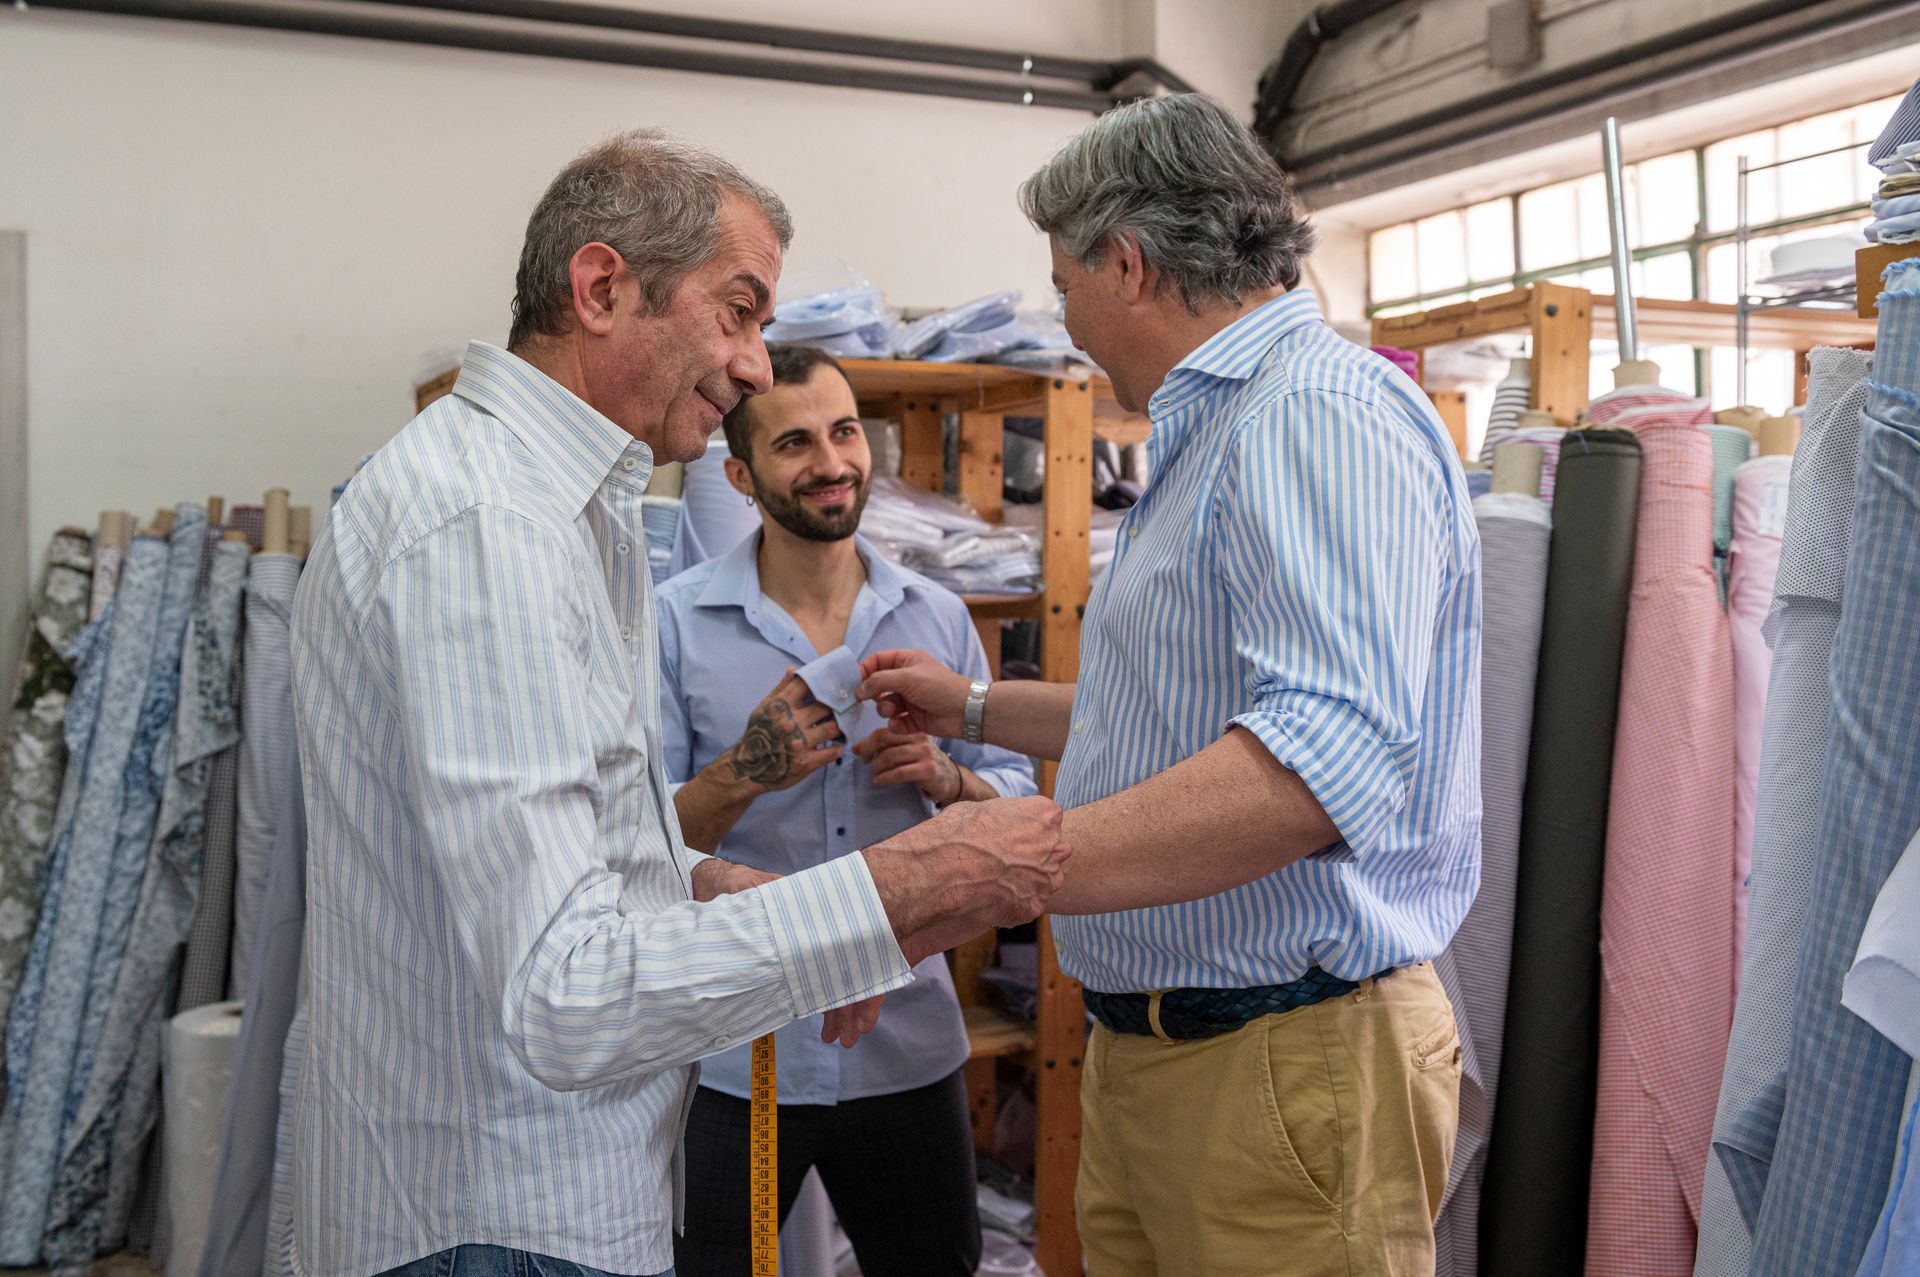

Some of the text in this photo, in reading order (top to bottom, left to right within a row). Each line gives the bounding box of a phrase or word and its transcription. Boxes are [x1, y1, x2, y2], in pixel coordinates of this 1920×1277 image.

[760, 1050, 769, 1059] 92
[760, 1063, 769, 1072] 91
[760, 1076, 769, 1086] 90
[760, 1090, 769, 1099] 89
[760, 1103, 769, 1112] 88
[760, 1117, 769, 1126] 87
[760, 1130, 769, 1139] 86
[760, 1143, 769, 1153] 85
[760, 1157, 769, 1166] 84
[760, 1170, 769, 1179] 83
[760, 1184, 769, 1192] 82
[760, 1197, 769, 1206] 81
[760, 1210, 769, 1219] 80
[760, 1223, 769, 1232] 79
[760, 1236, 769, 1246] 78
[760, 1250, 769, 1259] 77
[760, 1263, 769, 1272] 76
